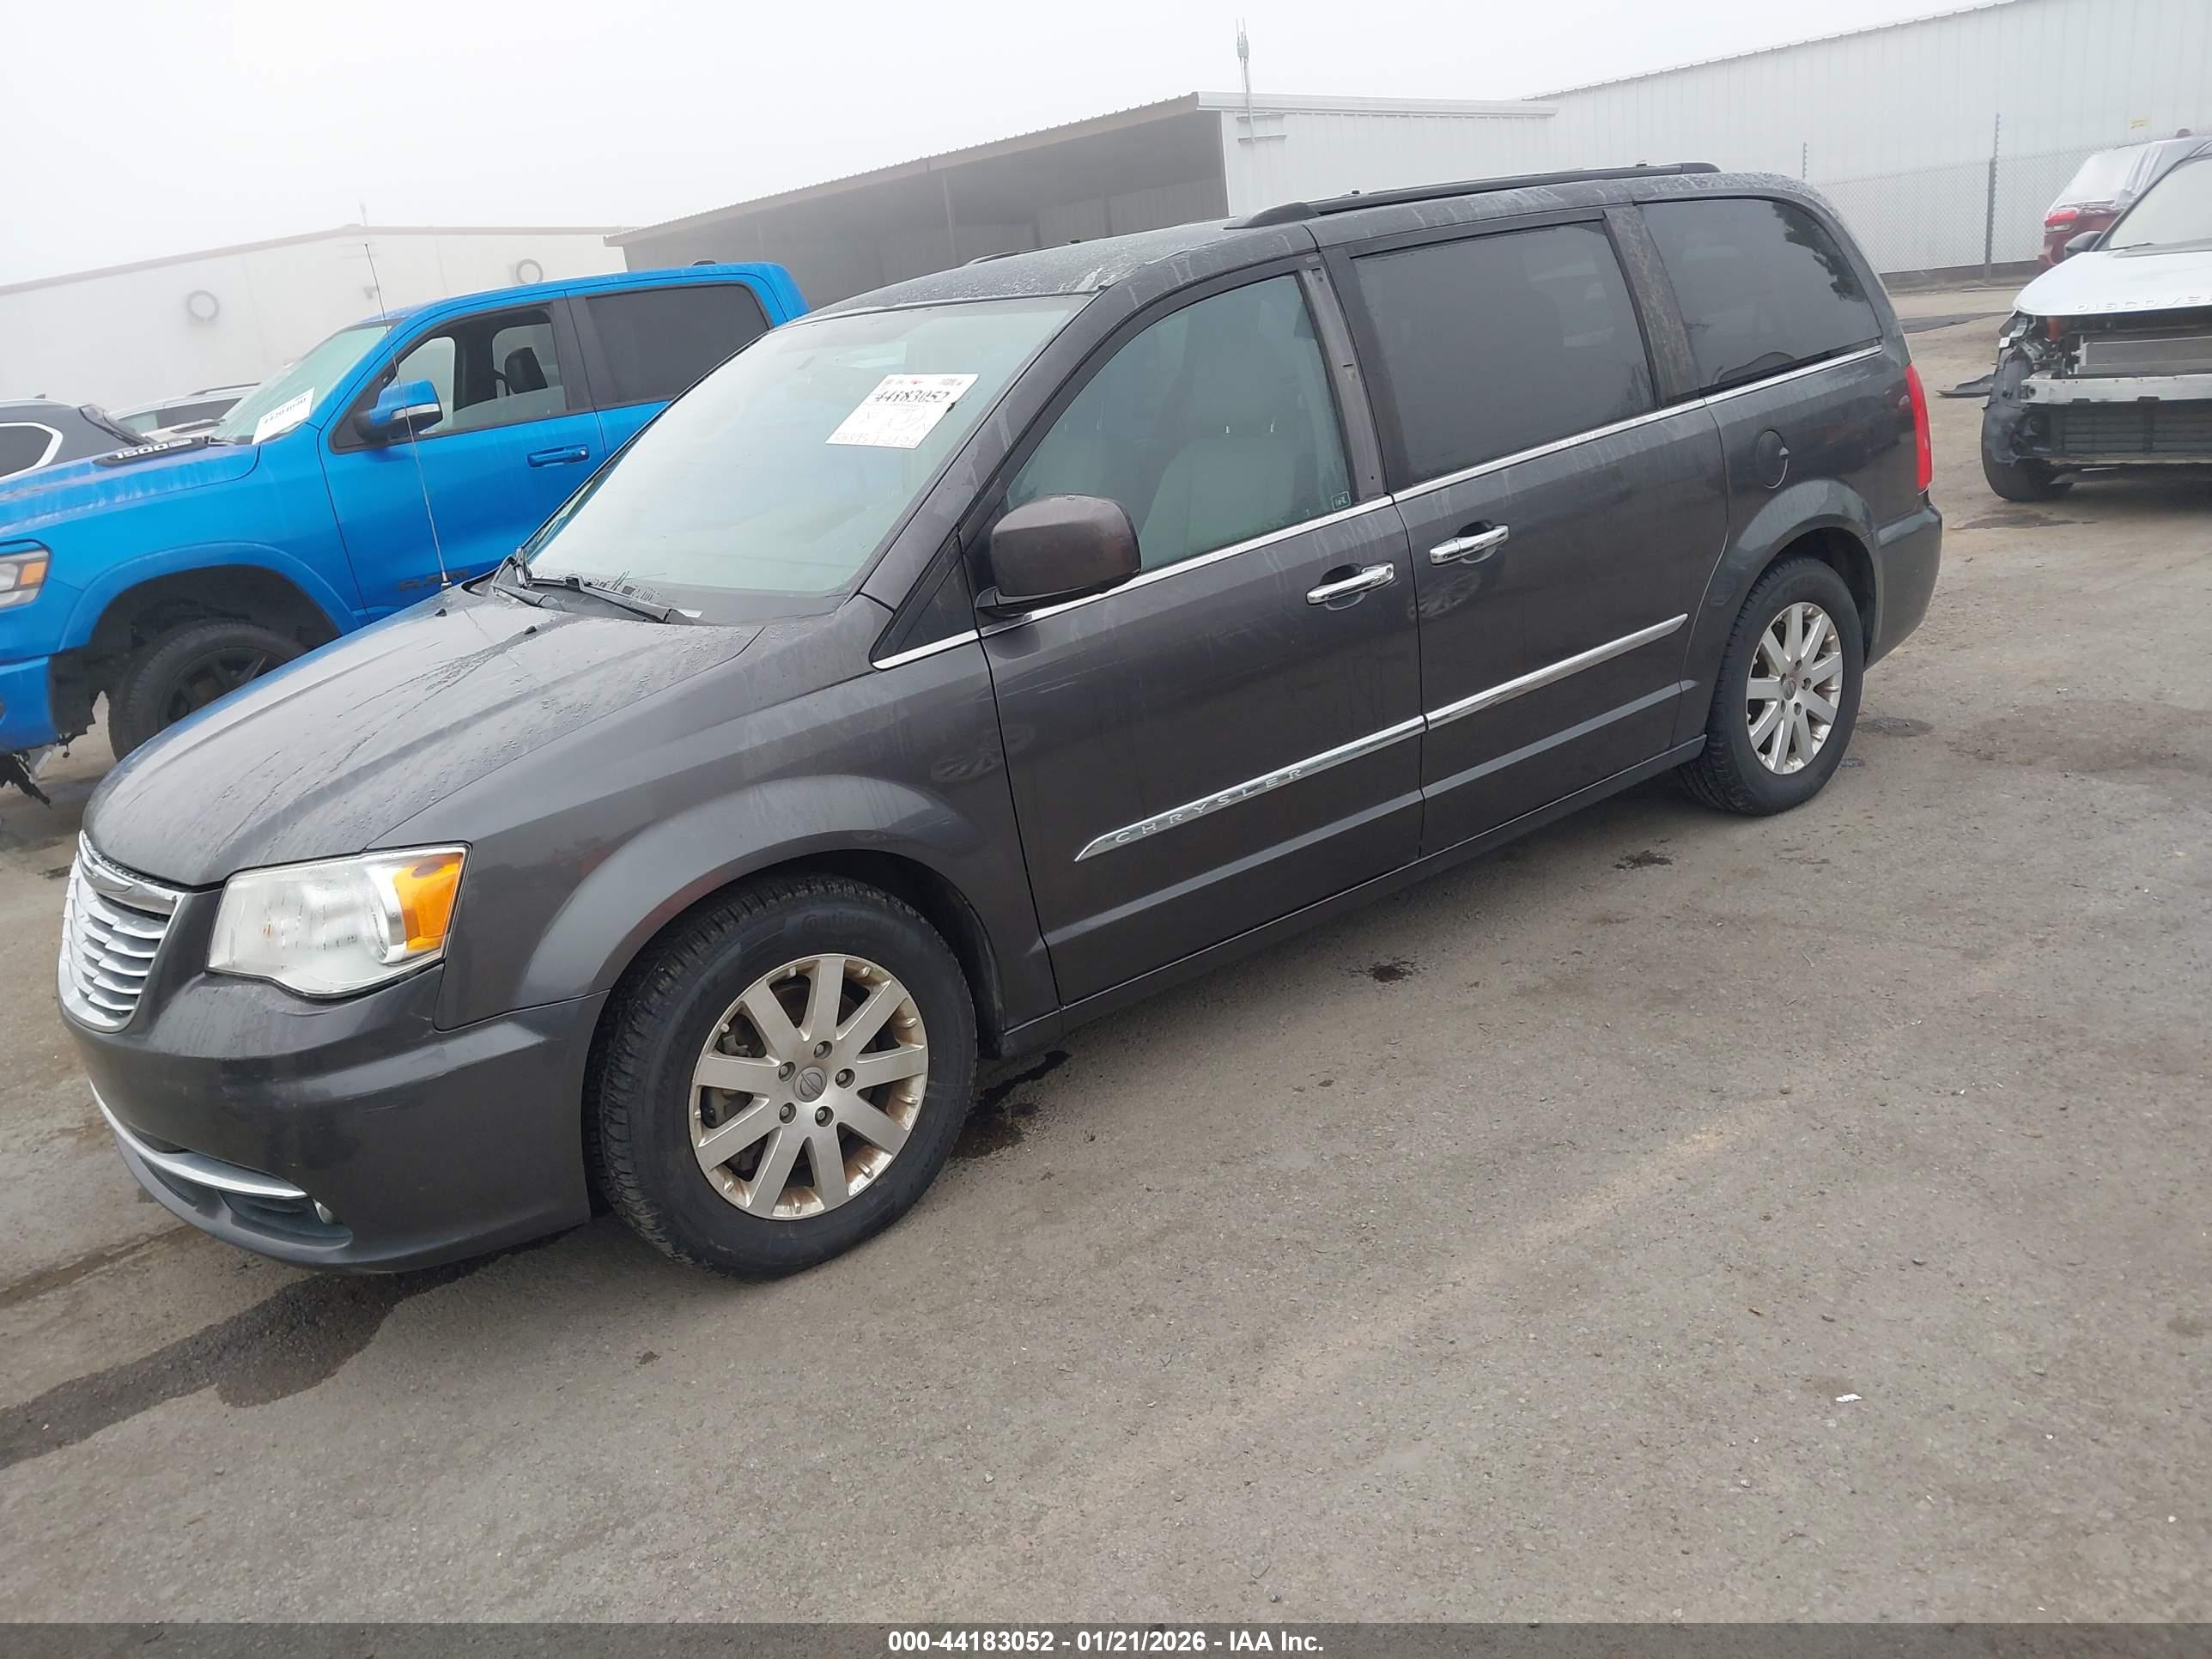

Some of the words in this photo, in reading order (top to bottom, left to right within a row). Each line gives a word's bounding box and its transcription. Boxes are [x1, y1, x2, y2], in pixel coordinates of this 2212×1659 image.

[2075, 295, 2212, 313] DISCOVE
[117, 441, 169, 459] 1500
[1115, 768, 1304, 844] CHRYSLER
